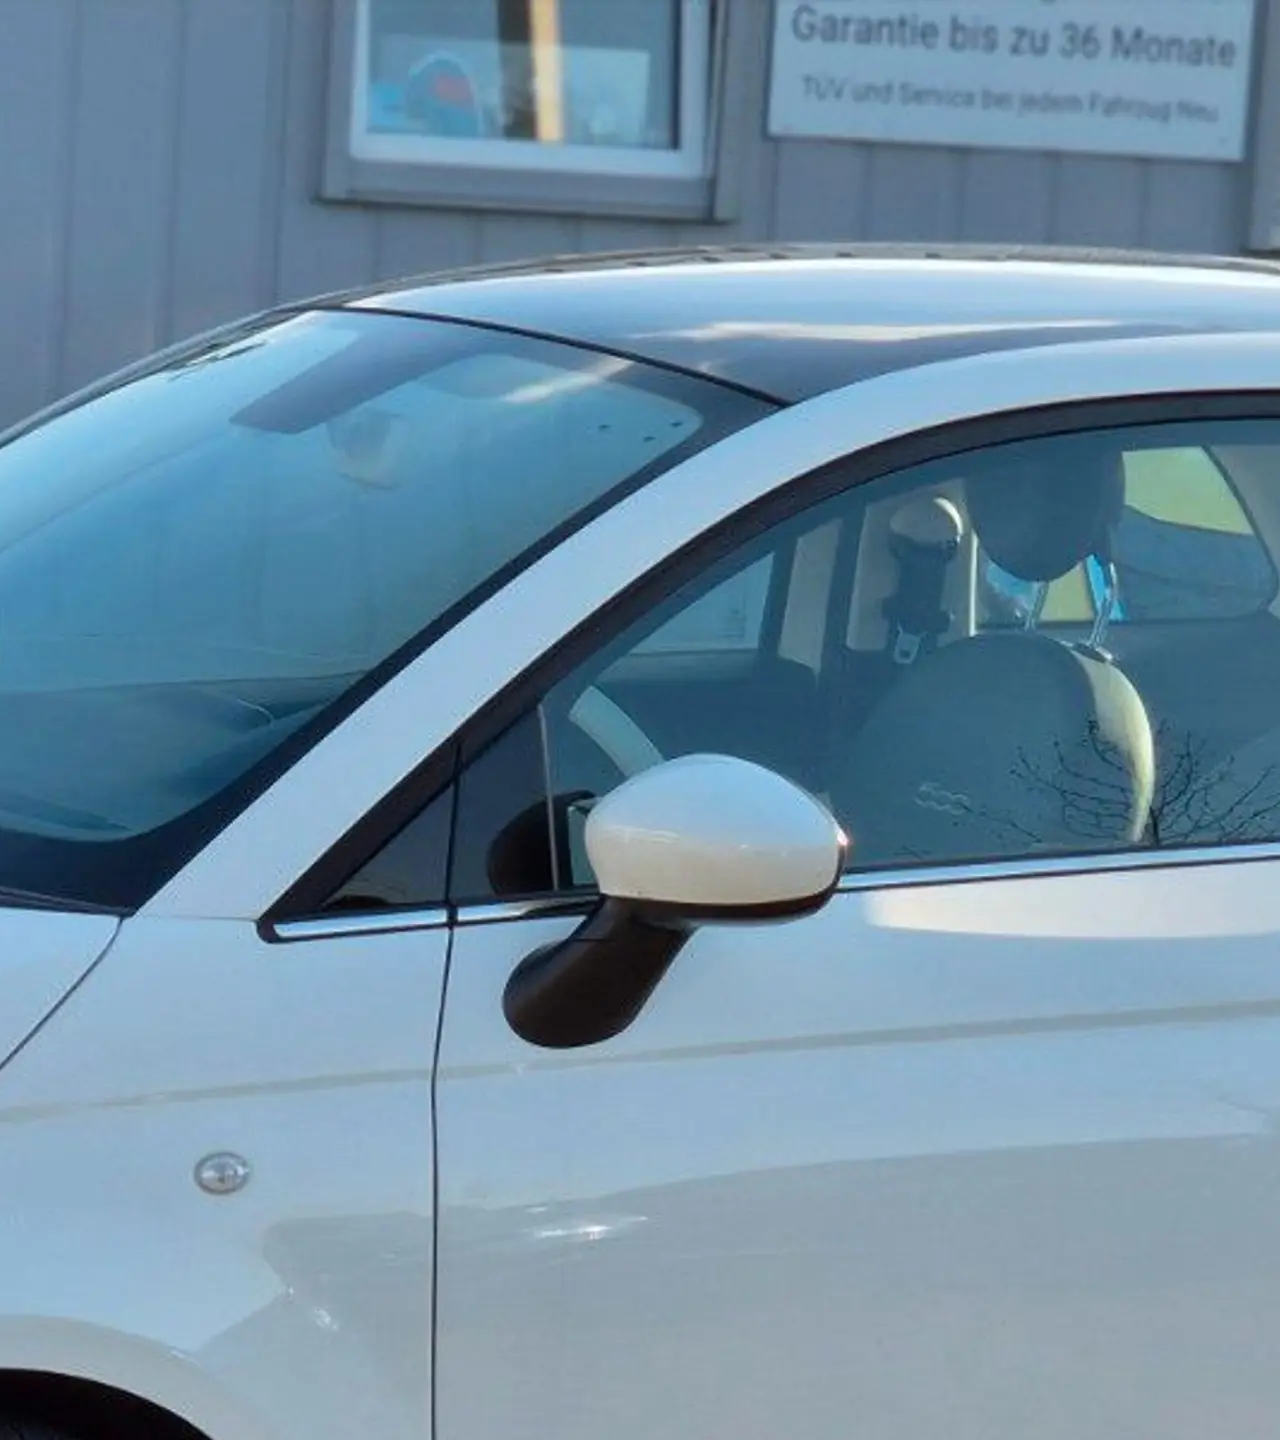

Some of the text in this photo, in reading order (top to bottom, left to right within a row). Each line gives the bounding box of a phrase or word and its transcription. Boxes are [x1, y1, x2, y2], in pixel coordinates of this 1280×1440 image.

[791, 4, 1237, 69] Garantie bis zu 36 Monate
[851, 79, 895, 105] und
[898, 81, 976, 108] Service
[981, 87, 1014, 111] bei
[1017, 90, 1084, 118] jedem
